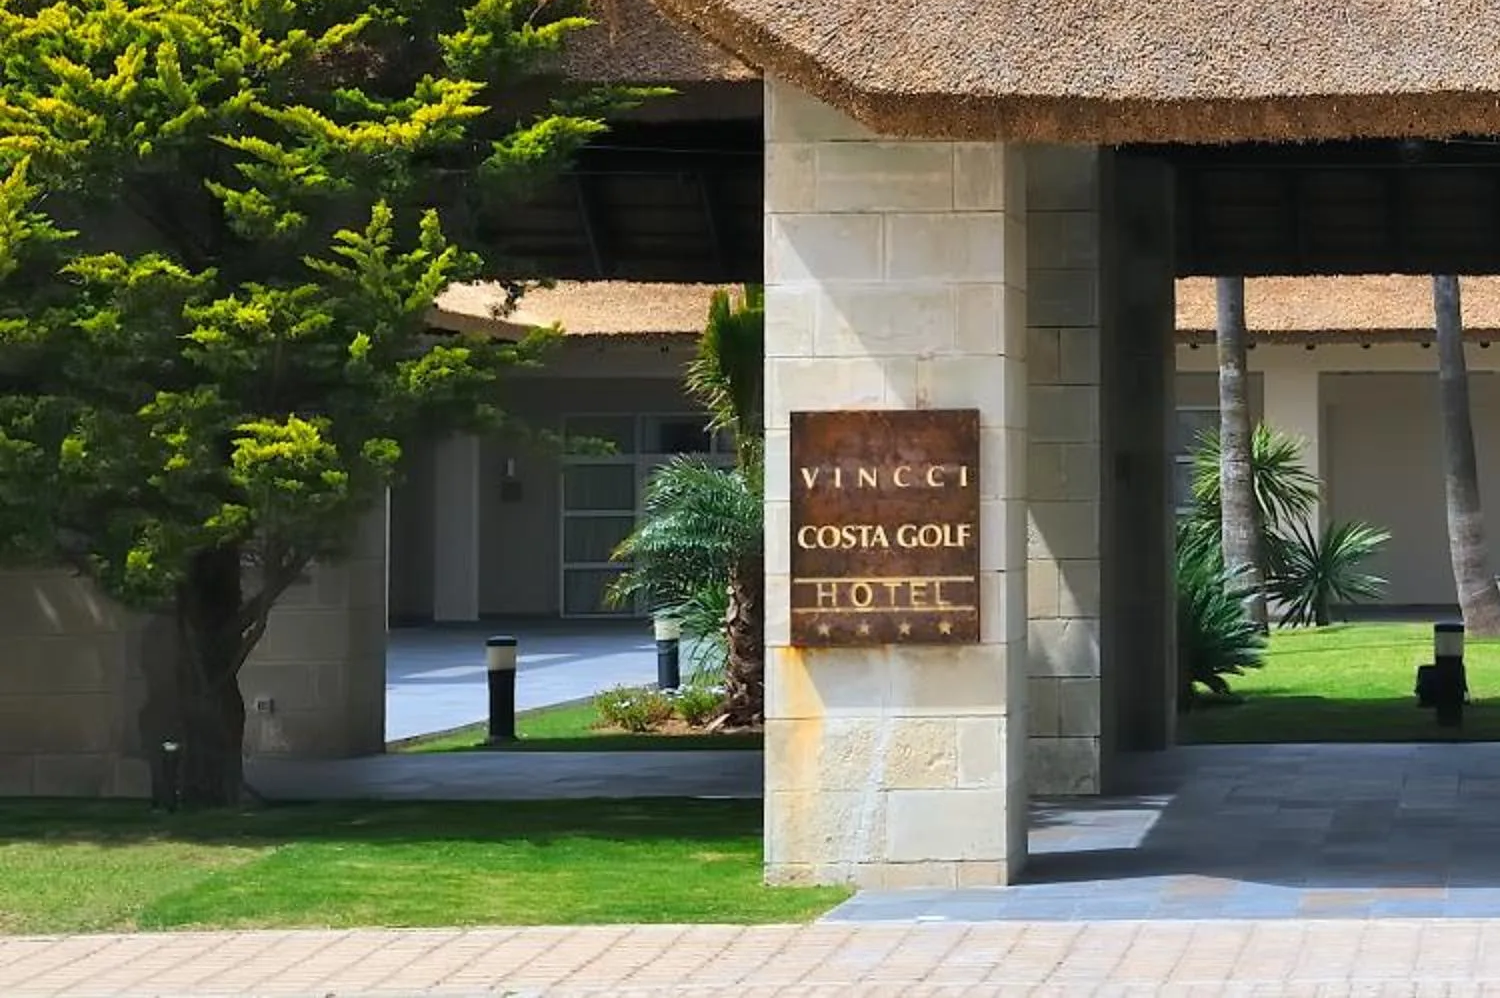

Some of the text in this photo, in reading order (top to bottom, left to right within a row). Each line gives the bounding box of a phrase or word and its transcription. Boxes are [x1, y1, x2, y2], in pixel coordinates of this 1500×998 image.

[801, 465, 968, 489] VINCCI
[797, 523, 971, 549] COSTA GOLF
[816, 581, 951, 607] HOTEL
